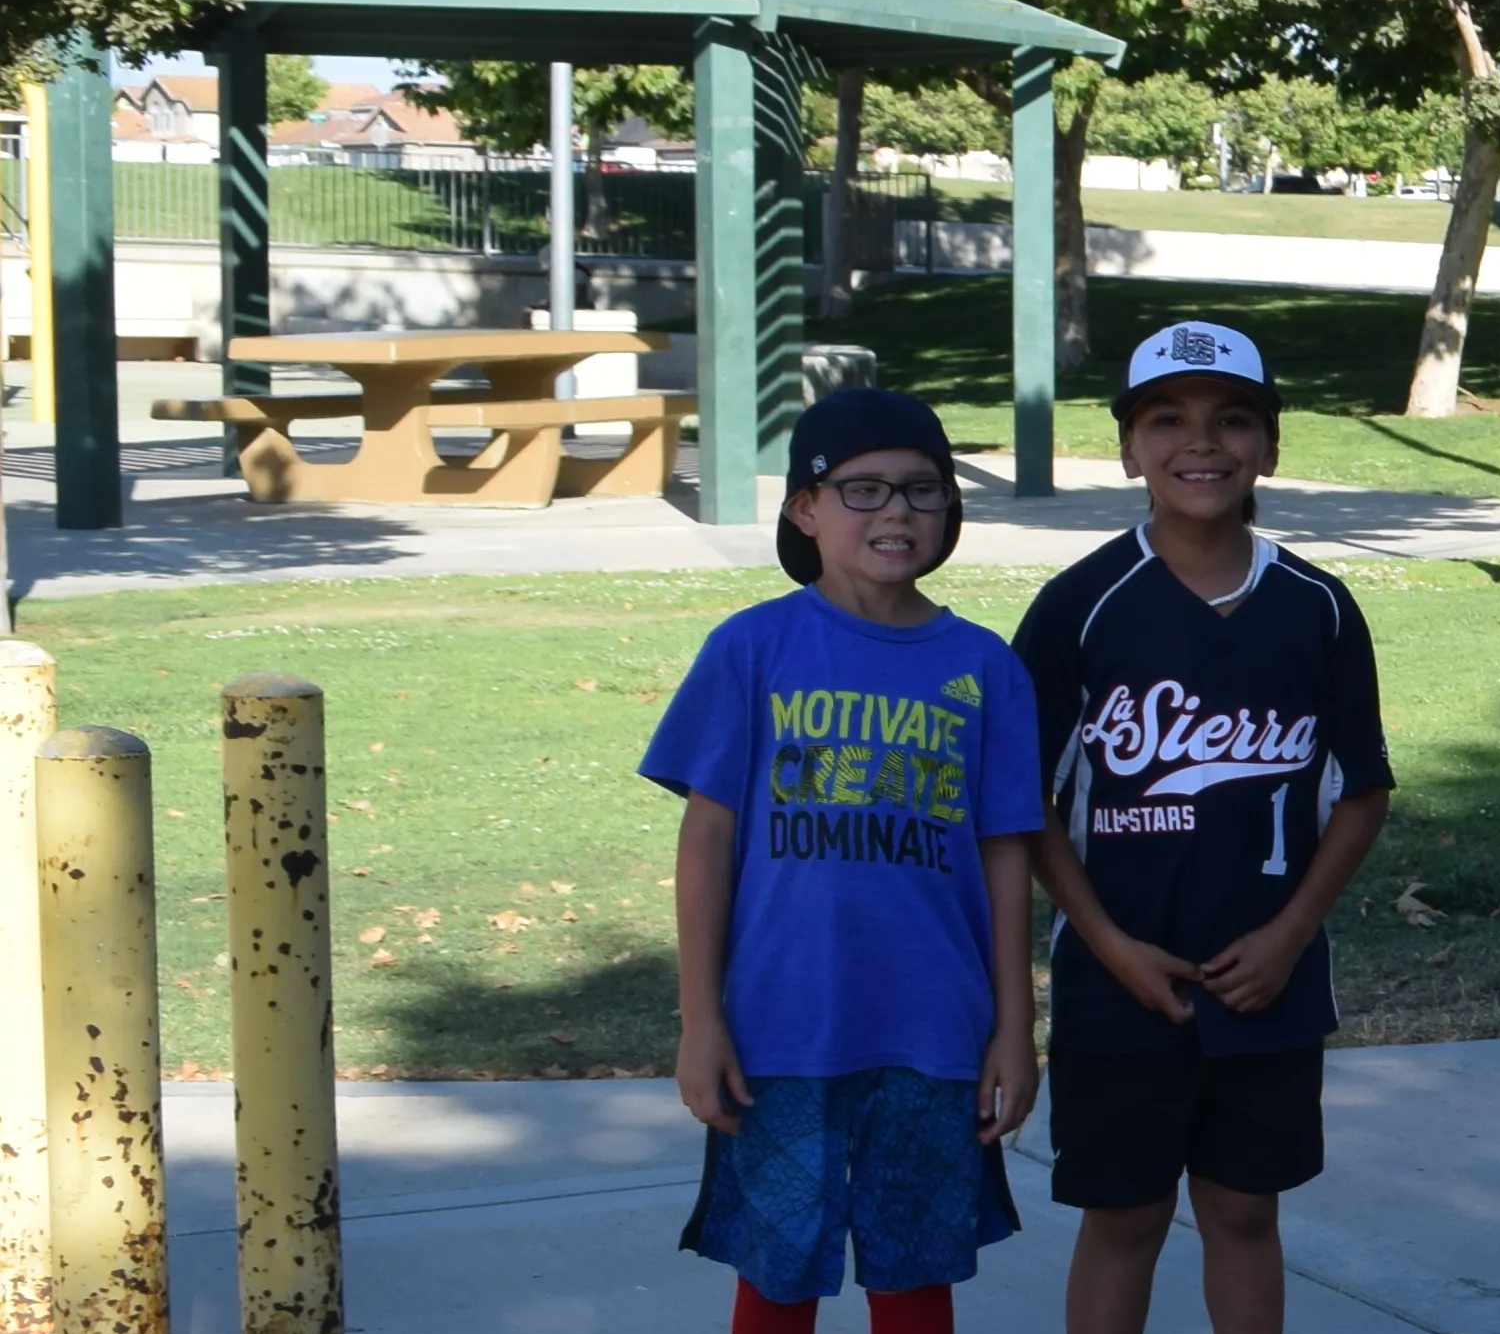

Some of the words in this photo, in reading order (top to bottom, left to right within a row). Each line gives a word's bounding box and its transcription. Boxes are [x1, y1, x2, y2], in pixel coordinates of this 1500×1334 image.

[770, 689, 967, 763] MOTIVATE
[941, 685, 981, 707] adida
[1082, 685, 1136, 744] La
[1105, 680, 1317, 776] Sierra
[770, 744, 967, 823] CREATE
[769, 811, 953, 875] DOMINATE
[1261, 783, 1290, 876] 1
